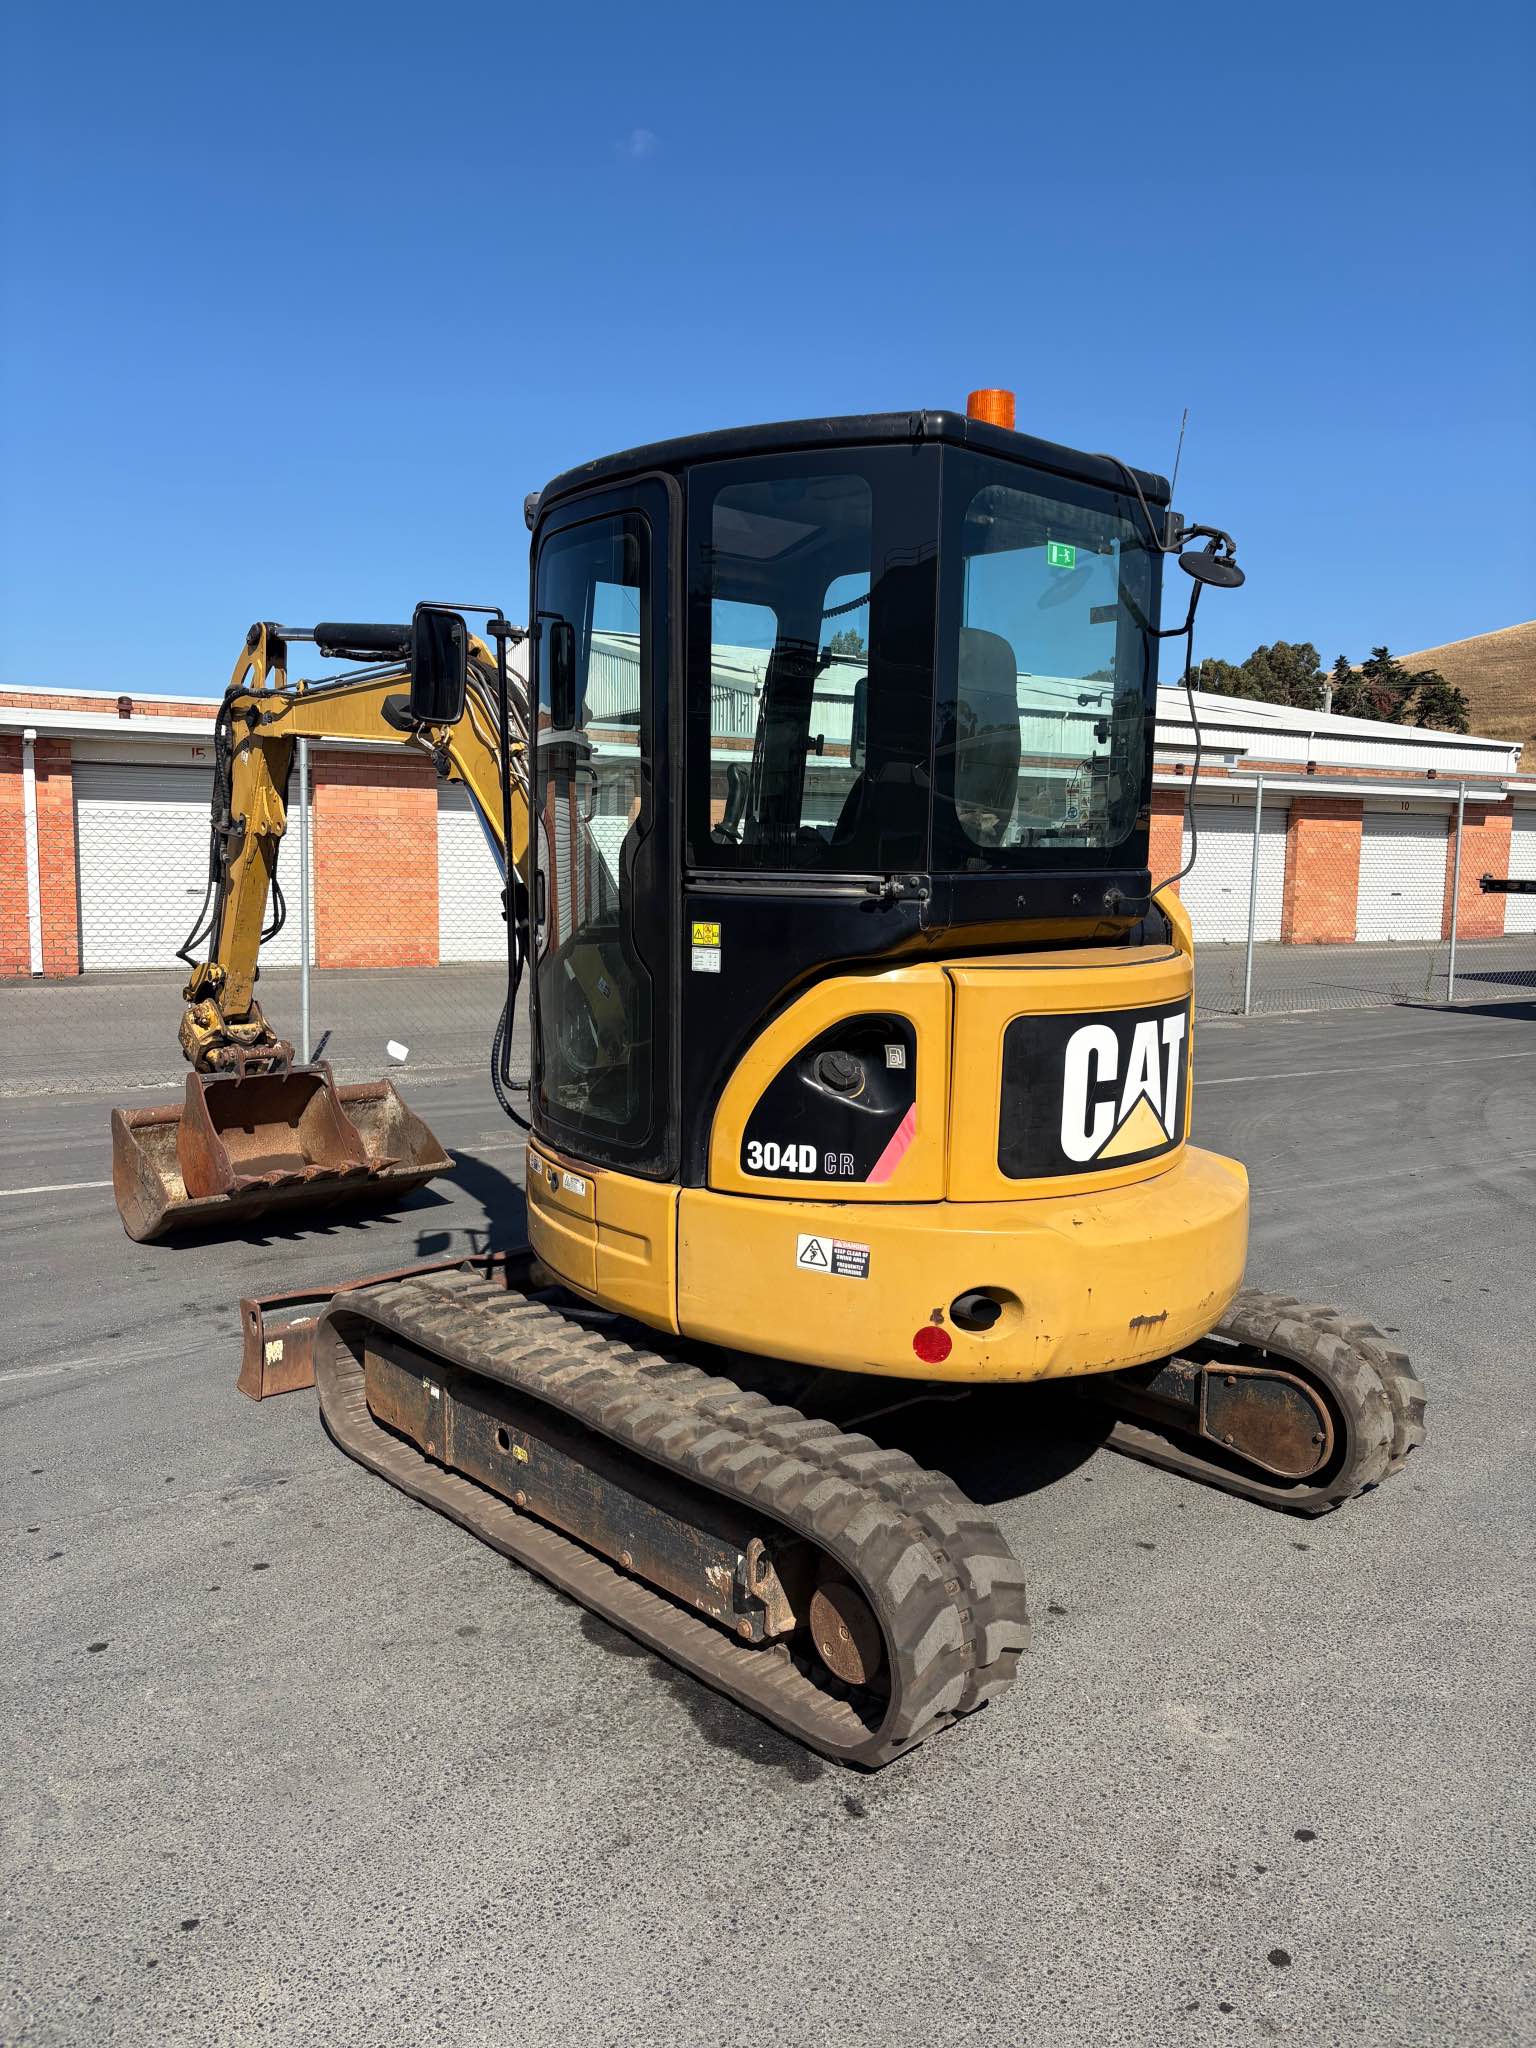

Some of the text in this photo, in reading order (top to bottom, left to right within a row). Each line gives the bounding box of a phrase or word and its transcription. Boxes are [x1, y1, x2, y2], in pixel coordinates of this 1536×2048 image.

[192, 747, 206, 760] 15
[1231, 793, 1240, 804] 11
[1400, 800, 1410, 811] 10
[1060, 1012, 1186, 1162] CAT
[747, 1140, 855, 1175] 304D CR
[837, 1262, 863, 1270] FREQUENTLY
